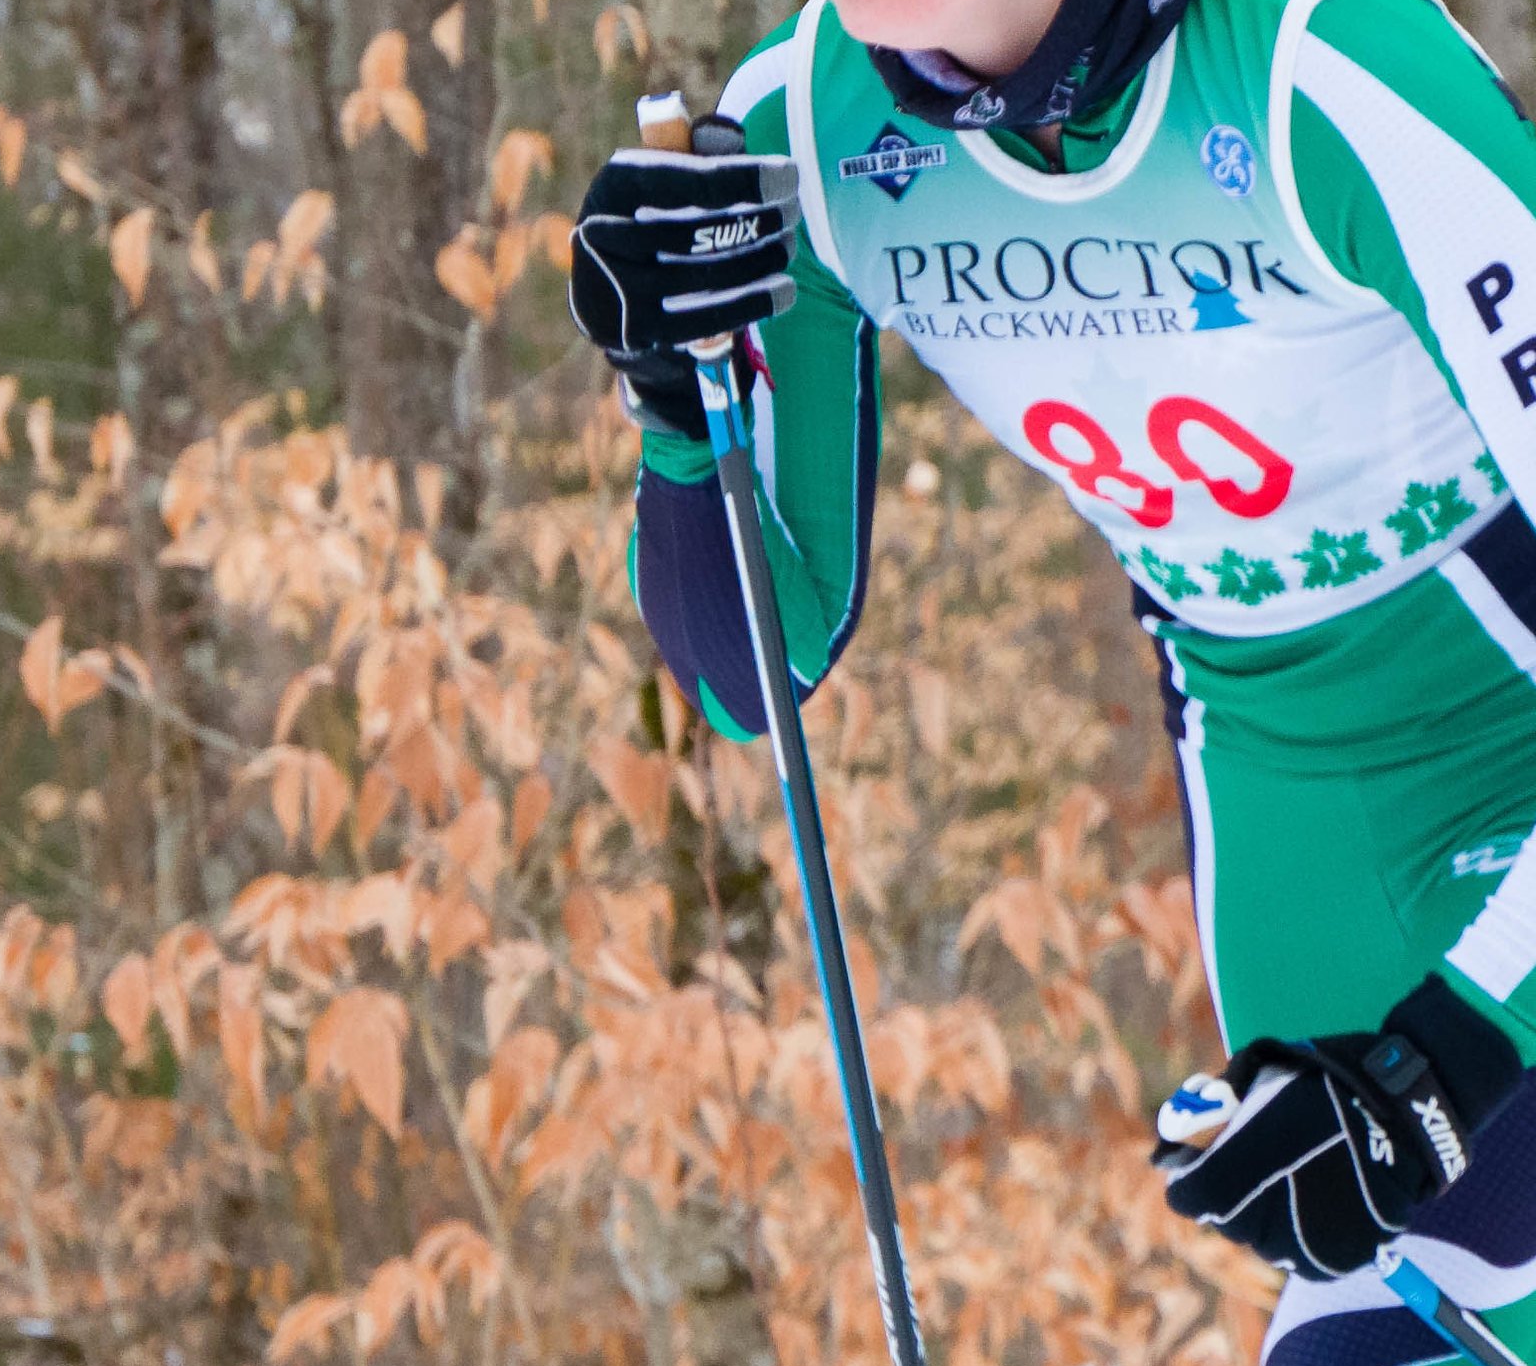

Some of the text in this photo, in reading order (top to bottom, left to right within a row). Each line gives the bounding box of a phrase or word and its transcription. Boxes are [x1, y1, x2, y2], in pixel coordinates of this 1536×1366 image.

[881, 151, 901, 171] CUP
[904, 146, 941, 168] SUPPLY
[904, 306, 1186, 340] BLACKWATER
[1022, 394, 1295, 529] 80
